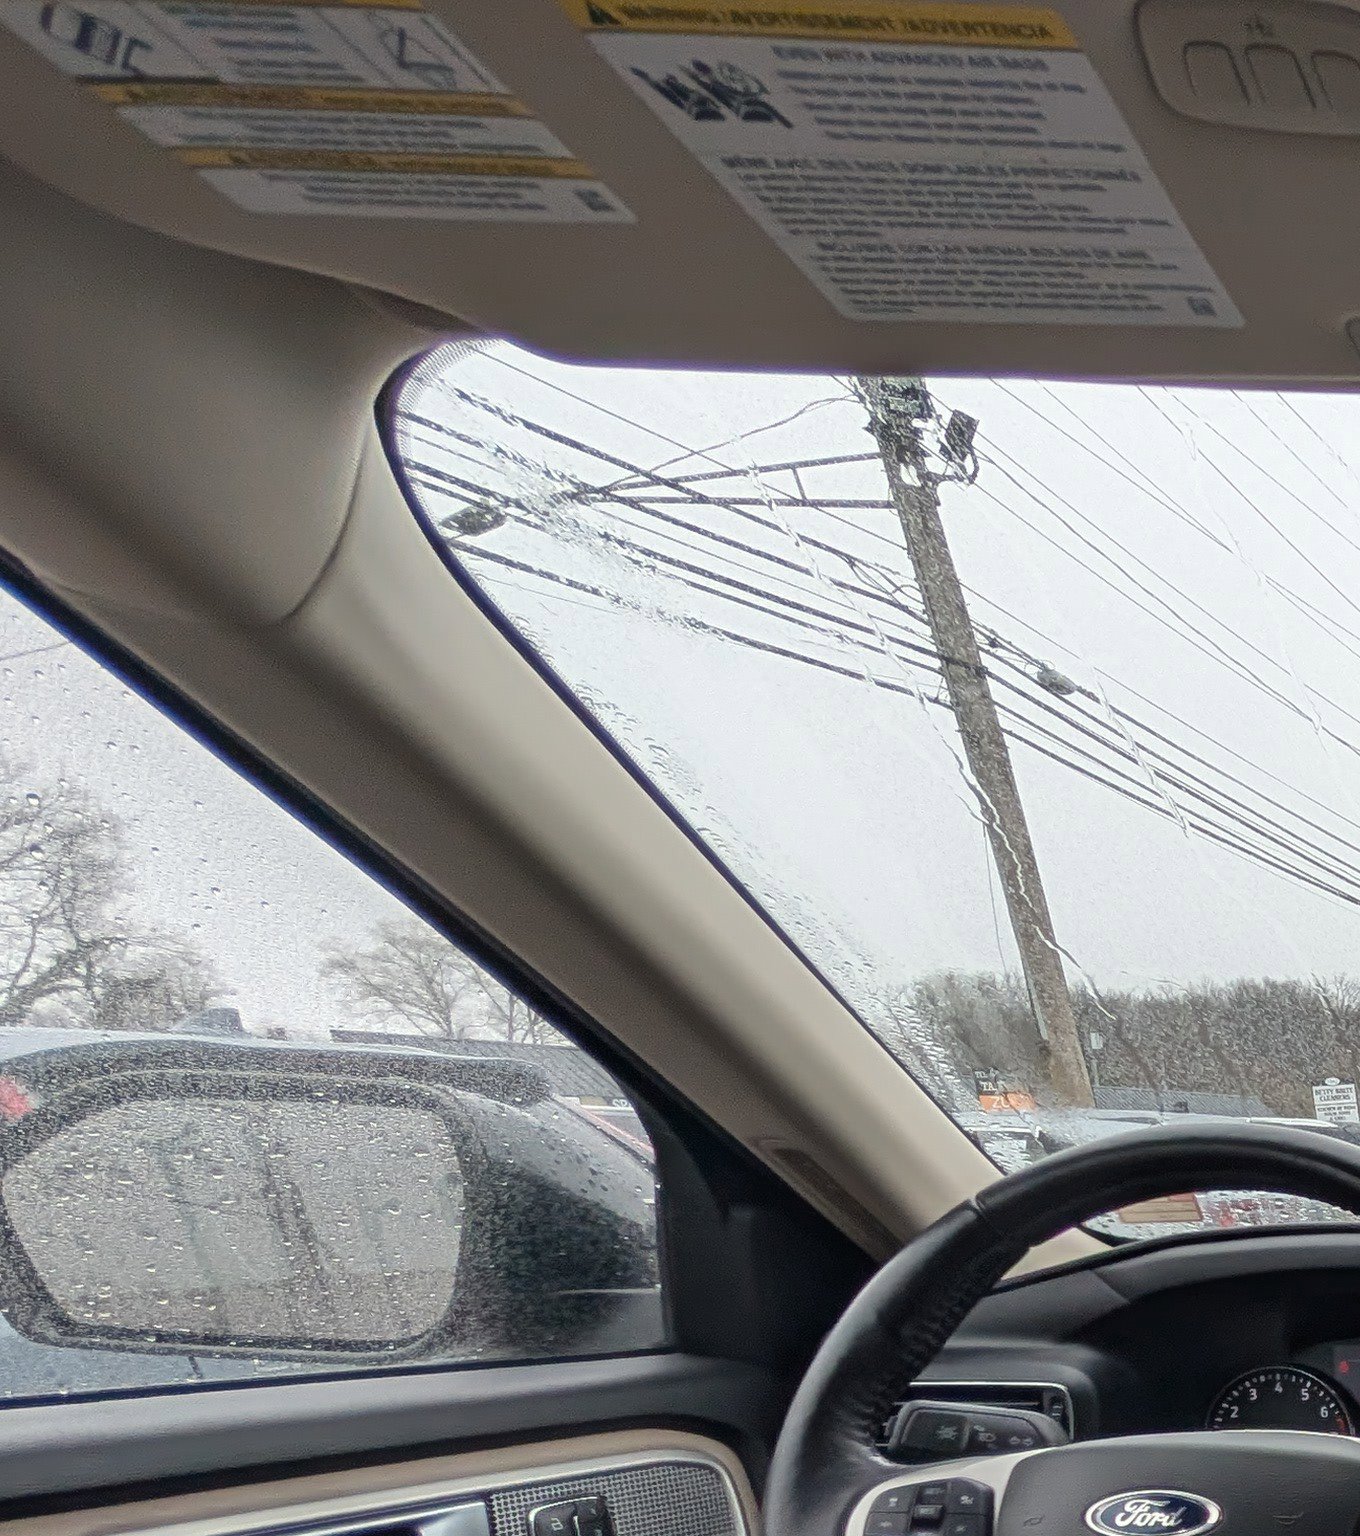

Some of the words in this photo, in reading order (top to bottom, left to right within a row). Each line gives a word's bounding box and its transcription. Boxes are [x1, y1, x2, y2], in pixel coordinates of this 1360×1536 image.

[1274, 1381, 1283, 1394] 4
[1249, 1388, 1258, 1401] 3
[1301, 1388, 1310, 1401] 5
[1230, 1406, 1239, 1419] 2
[1320, 1406, 1329, 1419] 6
[1114, 1499, 1188, 1527] Ford
